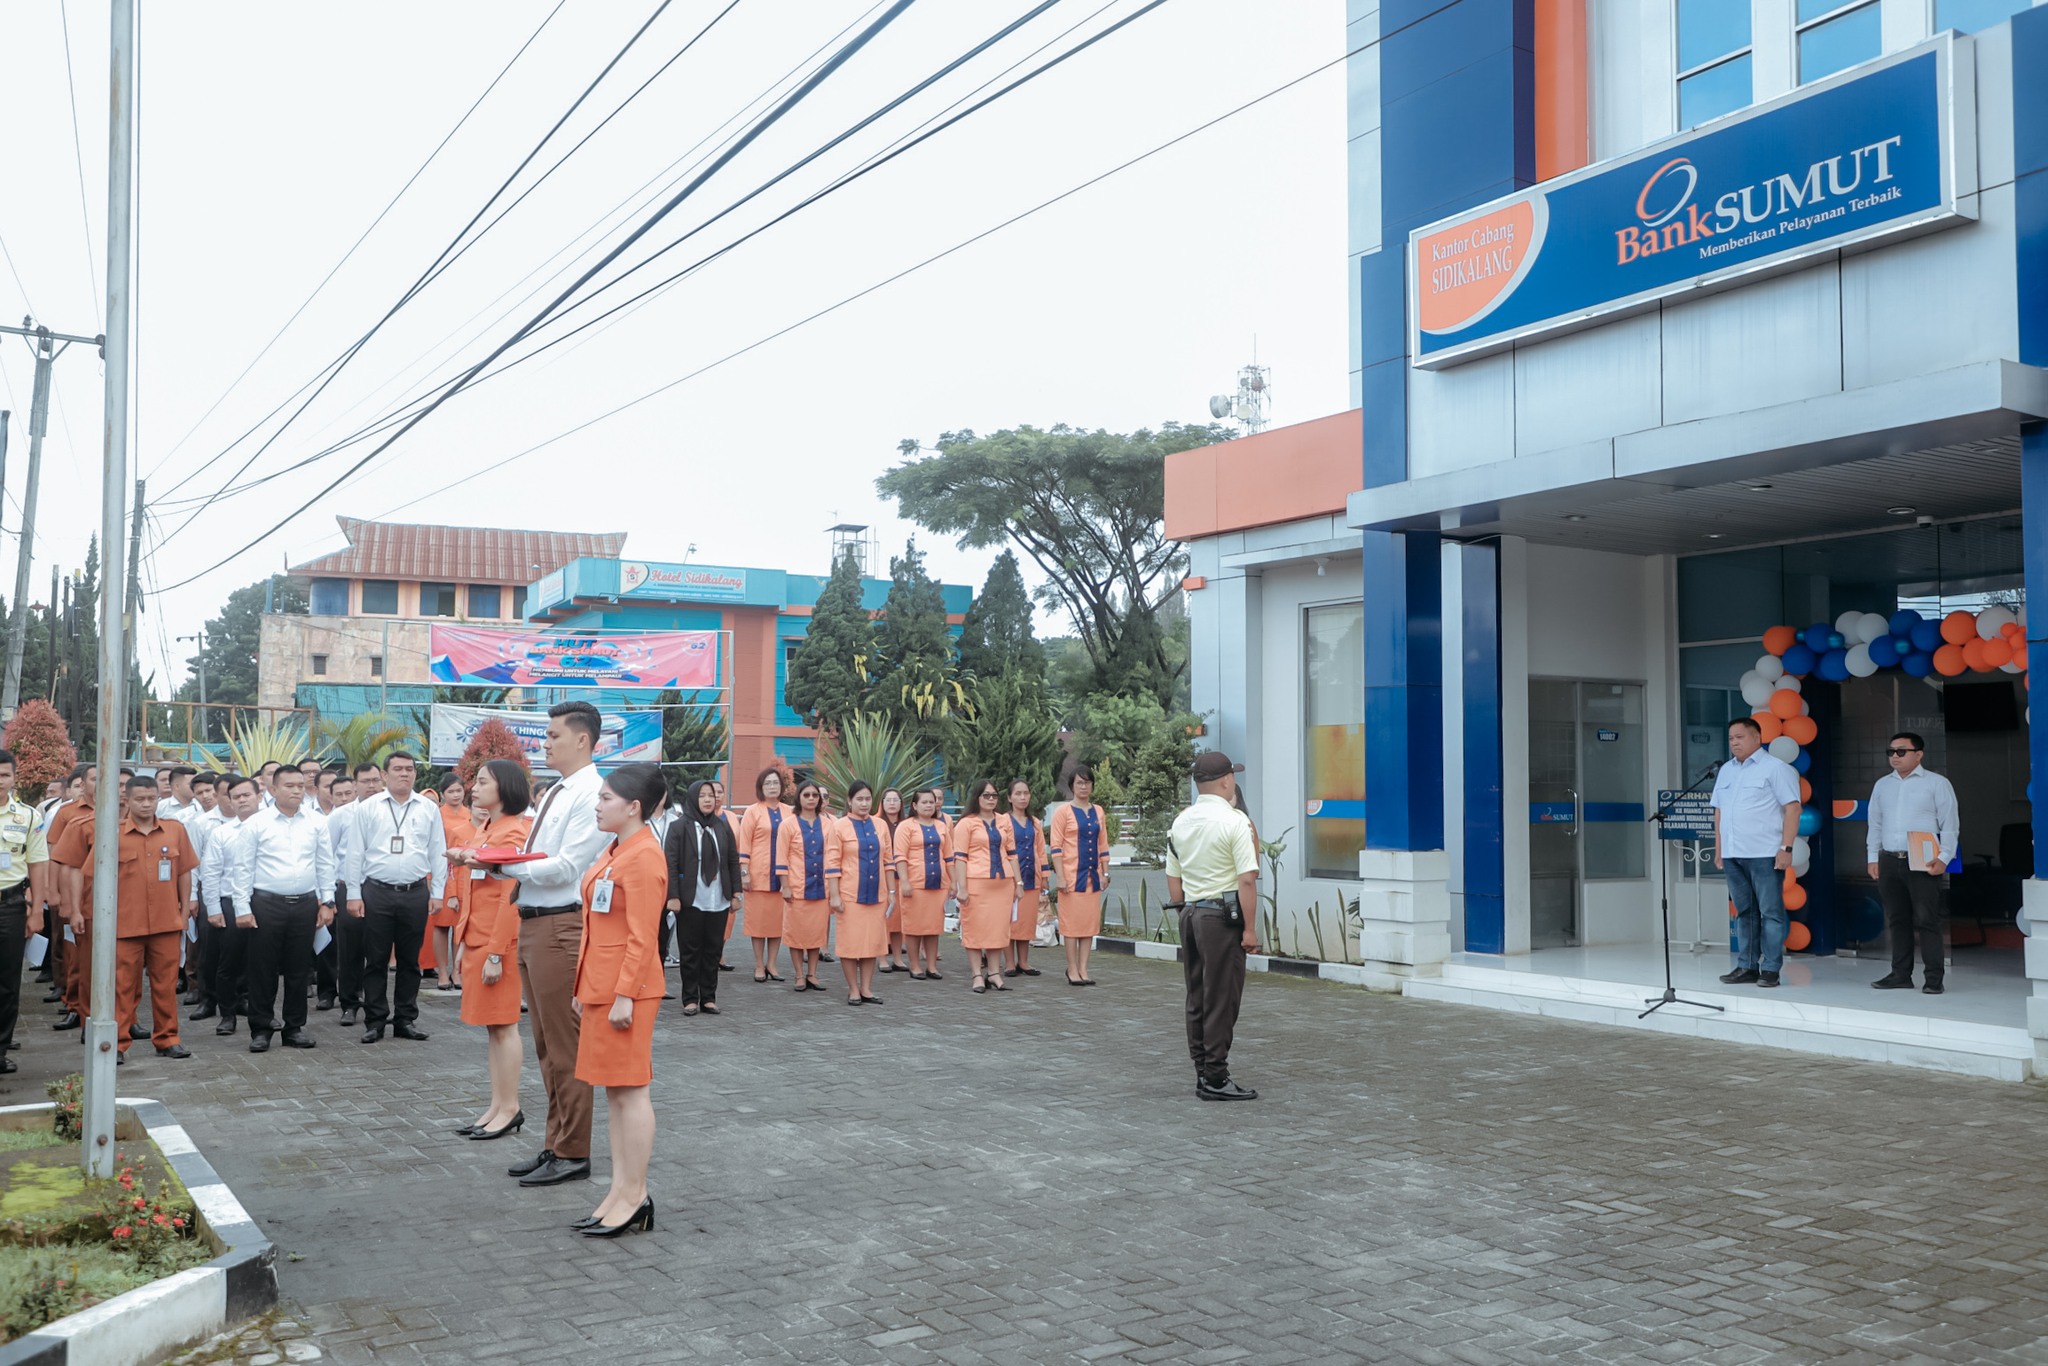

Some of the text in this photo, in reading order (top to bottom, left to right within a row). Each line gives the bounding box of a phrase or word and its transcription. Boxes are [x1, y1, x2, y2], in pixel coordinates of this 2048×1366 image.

[1699, 186, 1902, 259] Memberikan Pelayanan Terbaik
[1432, 223, 1514, 262] Kantor Cabang
[1432, 245, 1513, 294] SIDIKALANG
[650, 570, 682, 583] Hotel
[684, 571, 743, 588] Sidikalang
[553, 638, 597, 648] HUT
[559, 655, 592, 668] 62
